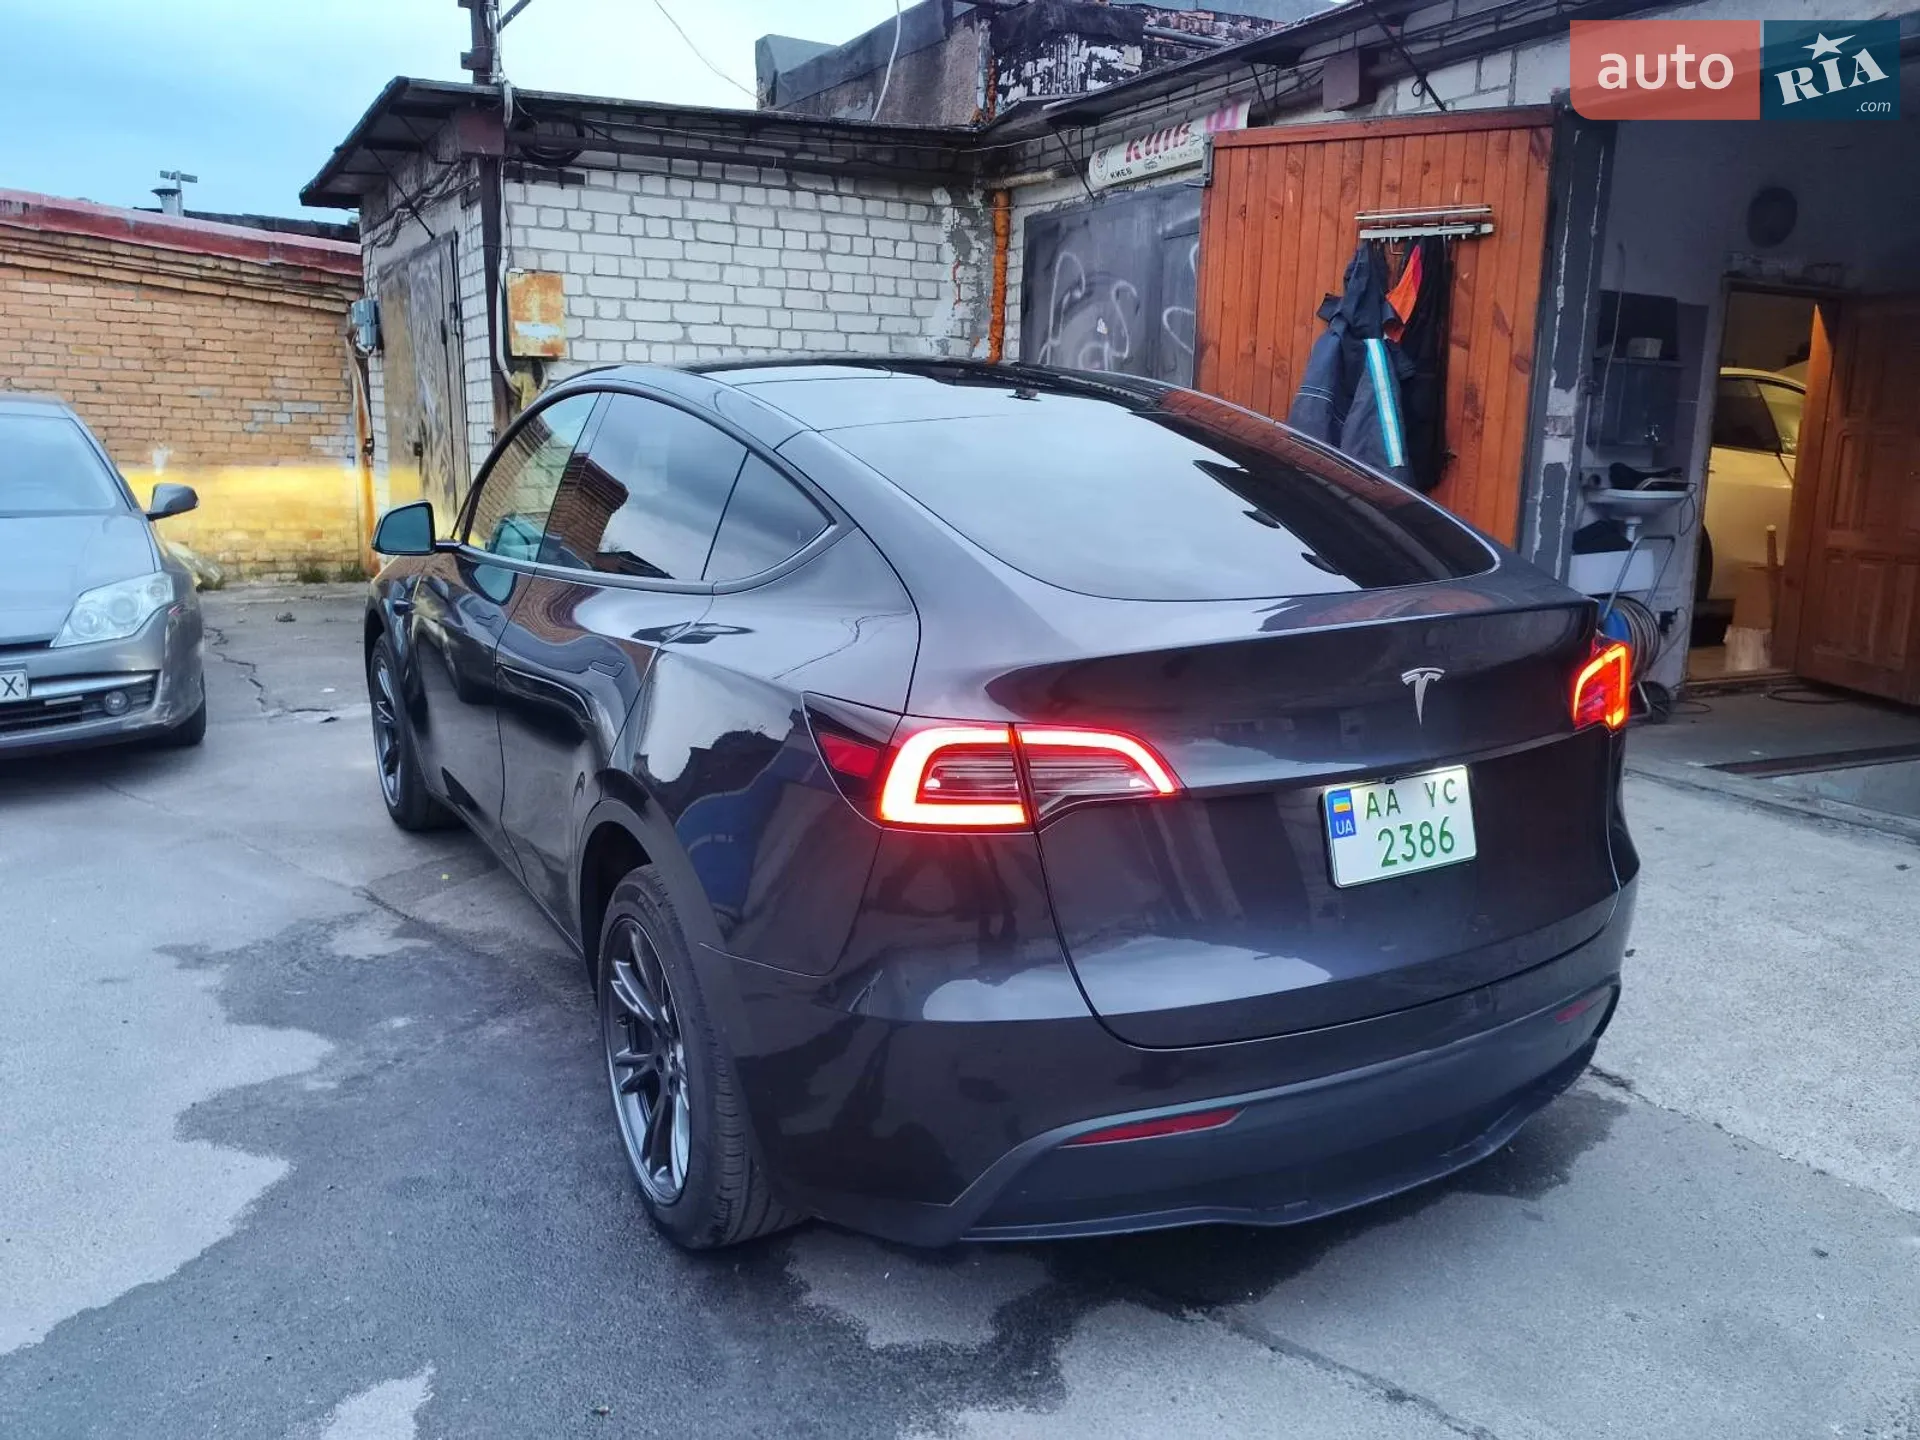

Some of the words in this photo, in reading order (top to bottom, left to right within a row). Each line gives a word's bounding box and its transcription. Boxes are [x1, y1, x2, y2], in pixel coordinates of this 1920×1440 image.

[1366, 788, 1401, 821] AA
[1335, 819, 1355, 836] UA
[1377, 816, 1455, 868] 2386
